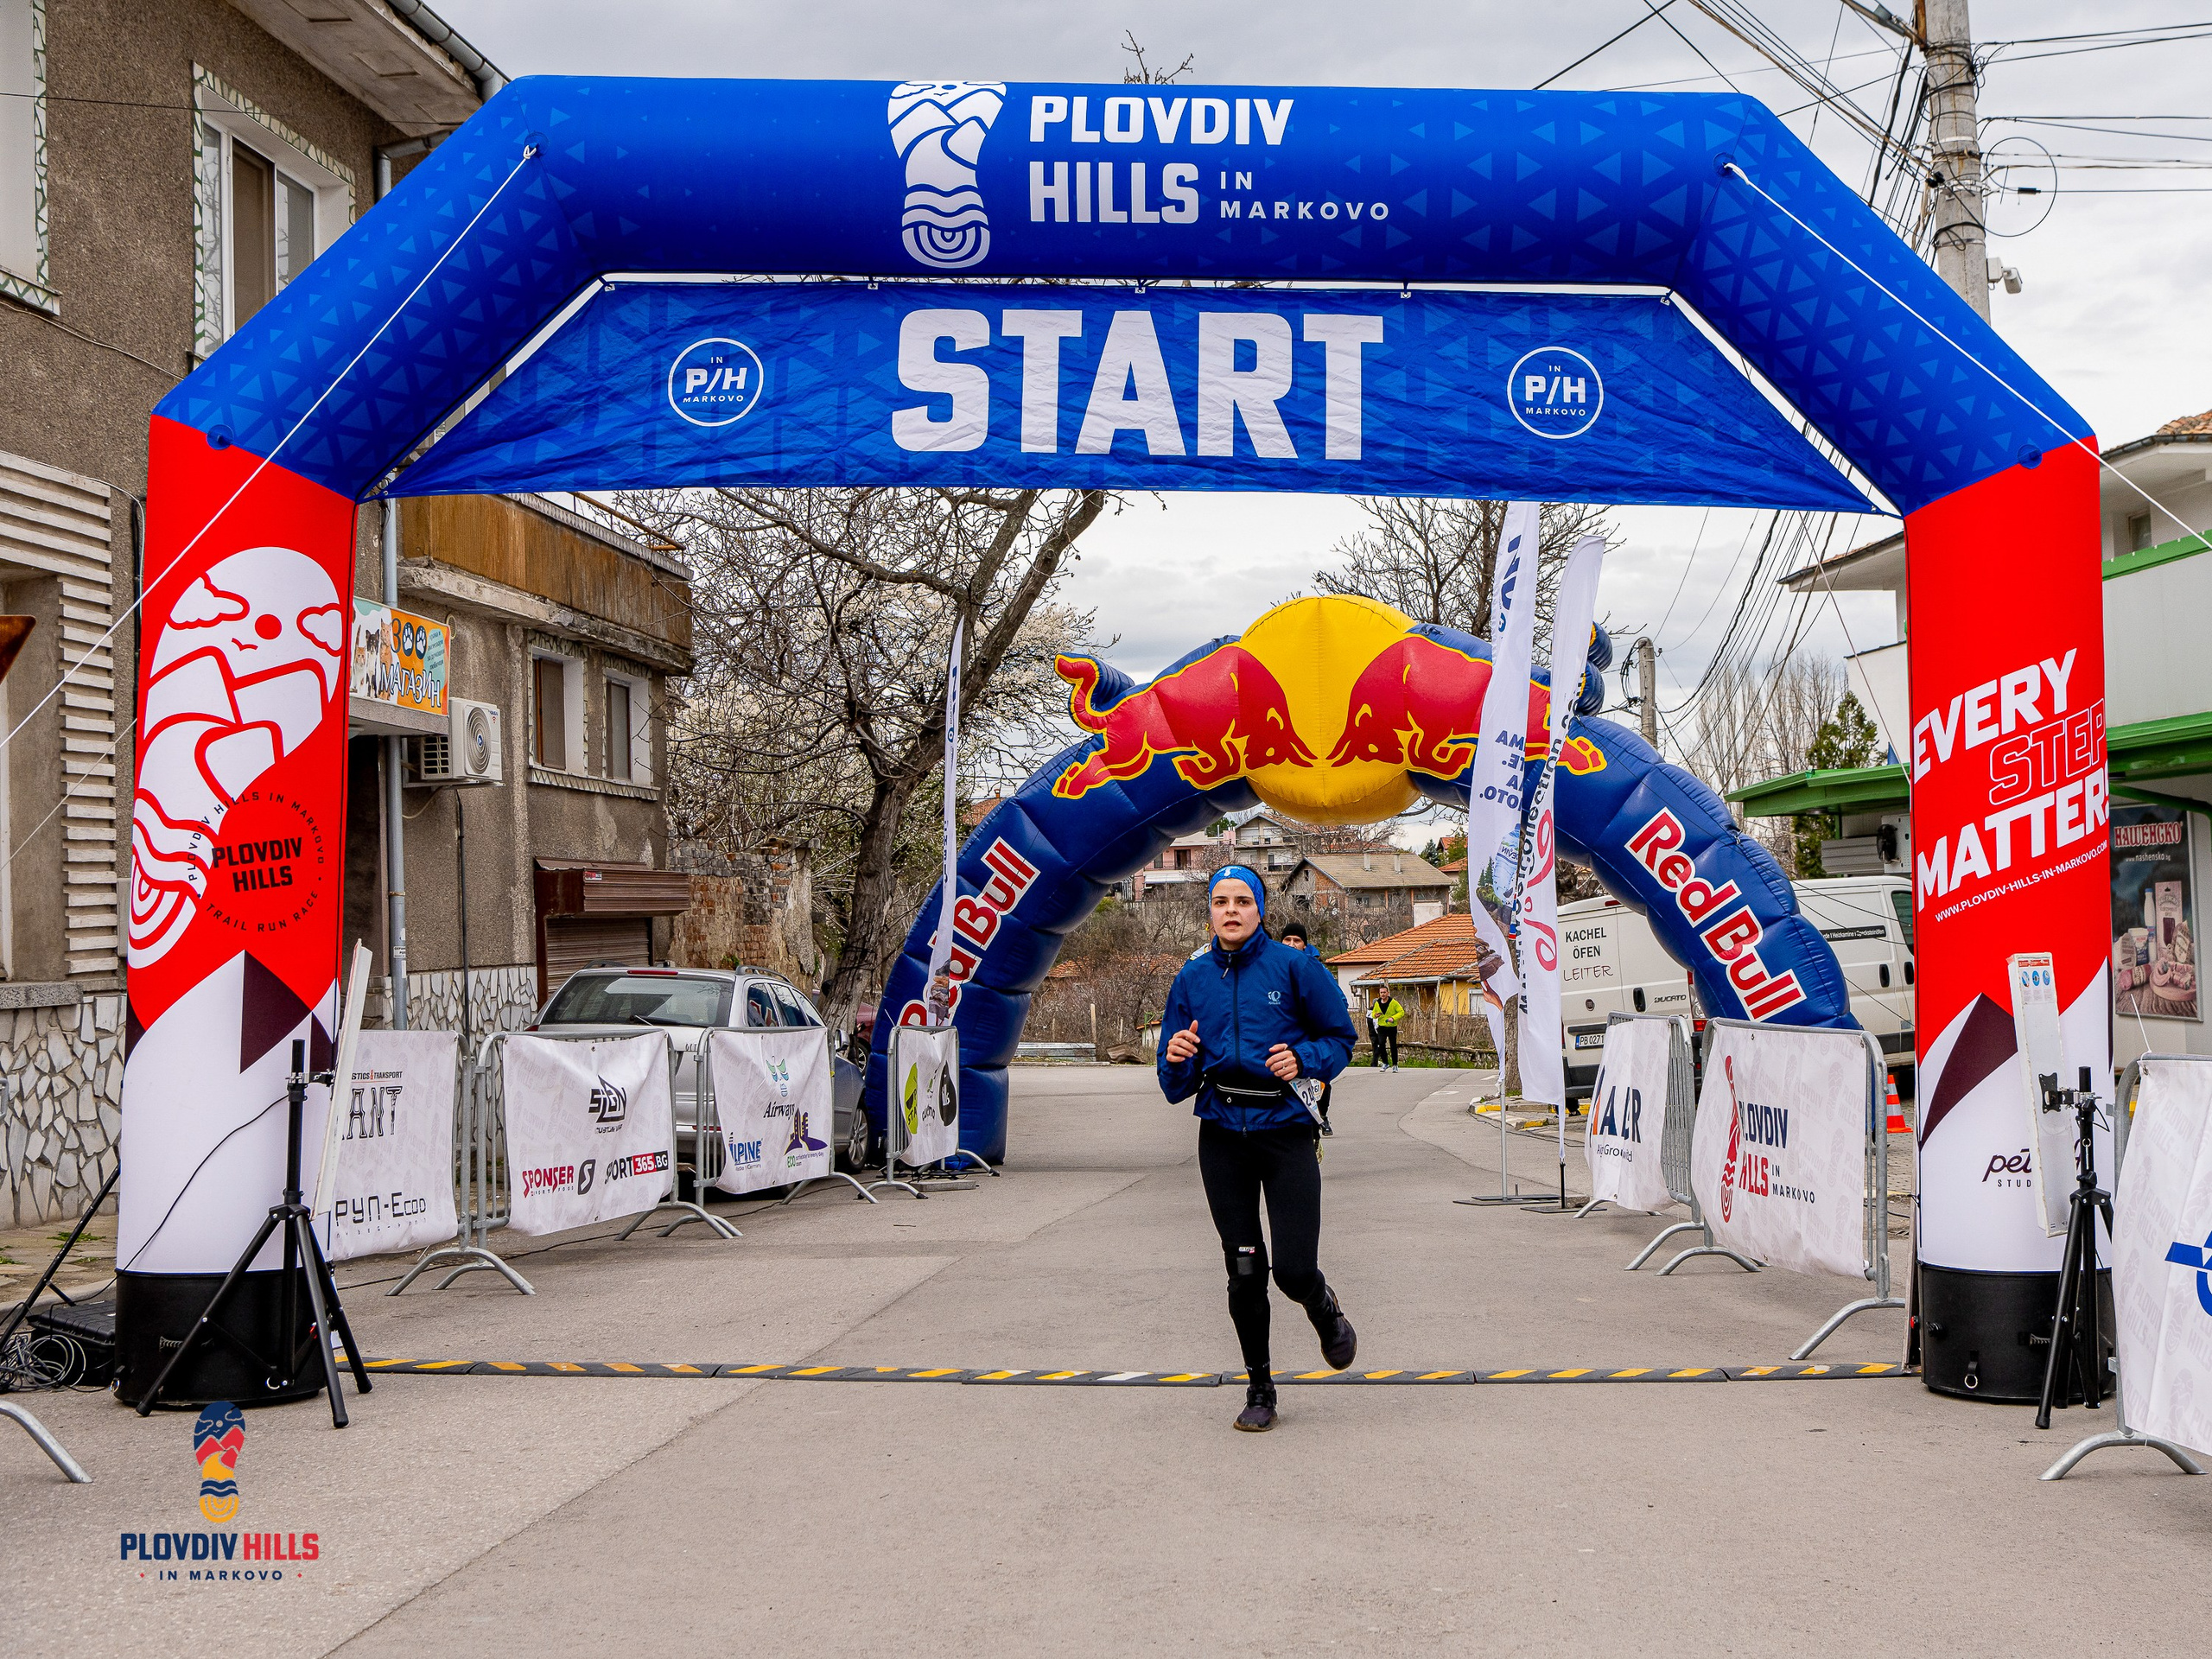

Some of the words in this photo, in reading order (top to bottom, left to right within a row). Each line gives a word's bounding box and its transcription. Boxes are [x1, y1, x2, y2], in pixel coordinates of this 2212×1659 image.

[1029, 96, 1294, 144] PLOVDIV
[1029, 161, 1198, 224] HILLS
[1220, 171, 1253, 189] IN
[1220, 200, 1389, 220] MARKOVO
[685, 367, 747, 394] P/H
[891, 308, 1383, 460] START
[1525, 375, 1586, 405] P/H
[1525, 407, 1586, 416] MARKOVO
[380, 662, 442, 708] МАГАЗИН
[1914, 647, 2077, 785] EVERY
[1989, 697, 2106, 806] STEP
[187, 816, 211, 881] PLOVDIV
[213, 791, 259, 815] HILLS
[270, 792, 284, 804] IN
[291, 801, 324, 864] MARKOVO
[2113, 822, 2182, 848] НАШЕНСКО
[212, 836, 302, 868] PLOVDIV
[232, 865, 293, 893] HILLS
[1935, 839, 2107, 923] WWW.PLOVDIV-HILLS-IN-MARKOVO.COM
[206, 903, 247, 931] TRAIL
[257, 919, 287, 932] RUN
[293, 891, 318, 922] RACE
[1629, 810, 1738, 924] Red
[1703, 907, 1802, 1020] Bull
[899, 933, 977, 1027] Rd
[952, 840, 1037, 947] Bull
[1565, 927, 1607, 943] KACHEL
[1573, 945, 1601, 959] ÖFEN
[1563, 965, 1613, 982] LEITER
[1654, 994, 1687, 1003] DUCATO
[1590, 1035, 1605, 1045] 0271
[346, 1085, 403, 1140] ANT
[763, 1102, 795, 1120] Airways
[1738, 1150, 1769, 1198] HLLS
[1771, 1164, 1780, 1178] IN
[1981, 1147, 2032, 1182] pet
[522, 1166, 575, 1198] SPONSER
[1772, 1183, 1815, 1204] MARKOVO
[1997, 1179, 2031, 1188] STUD
